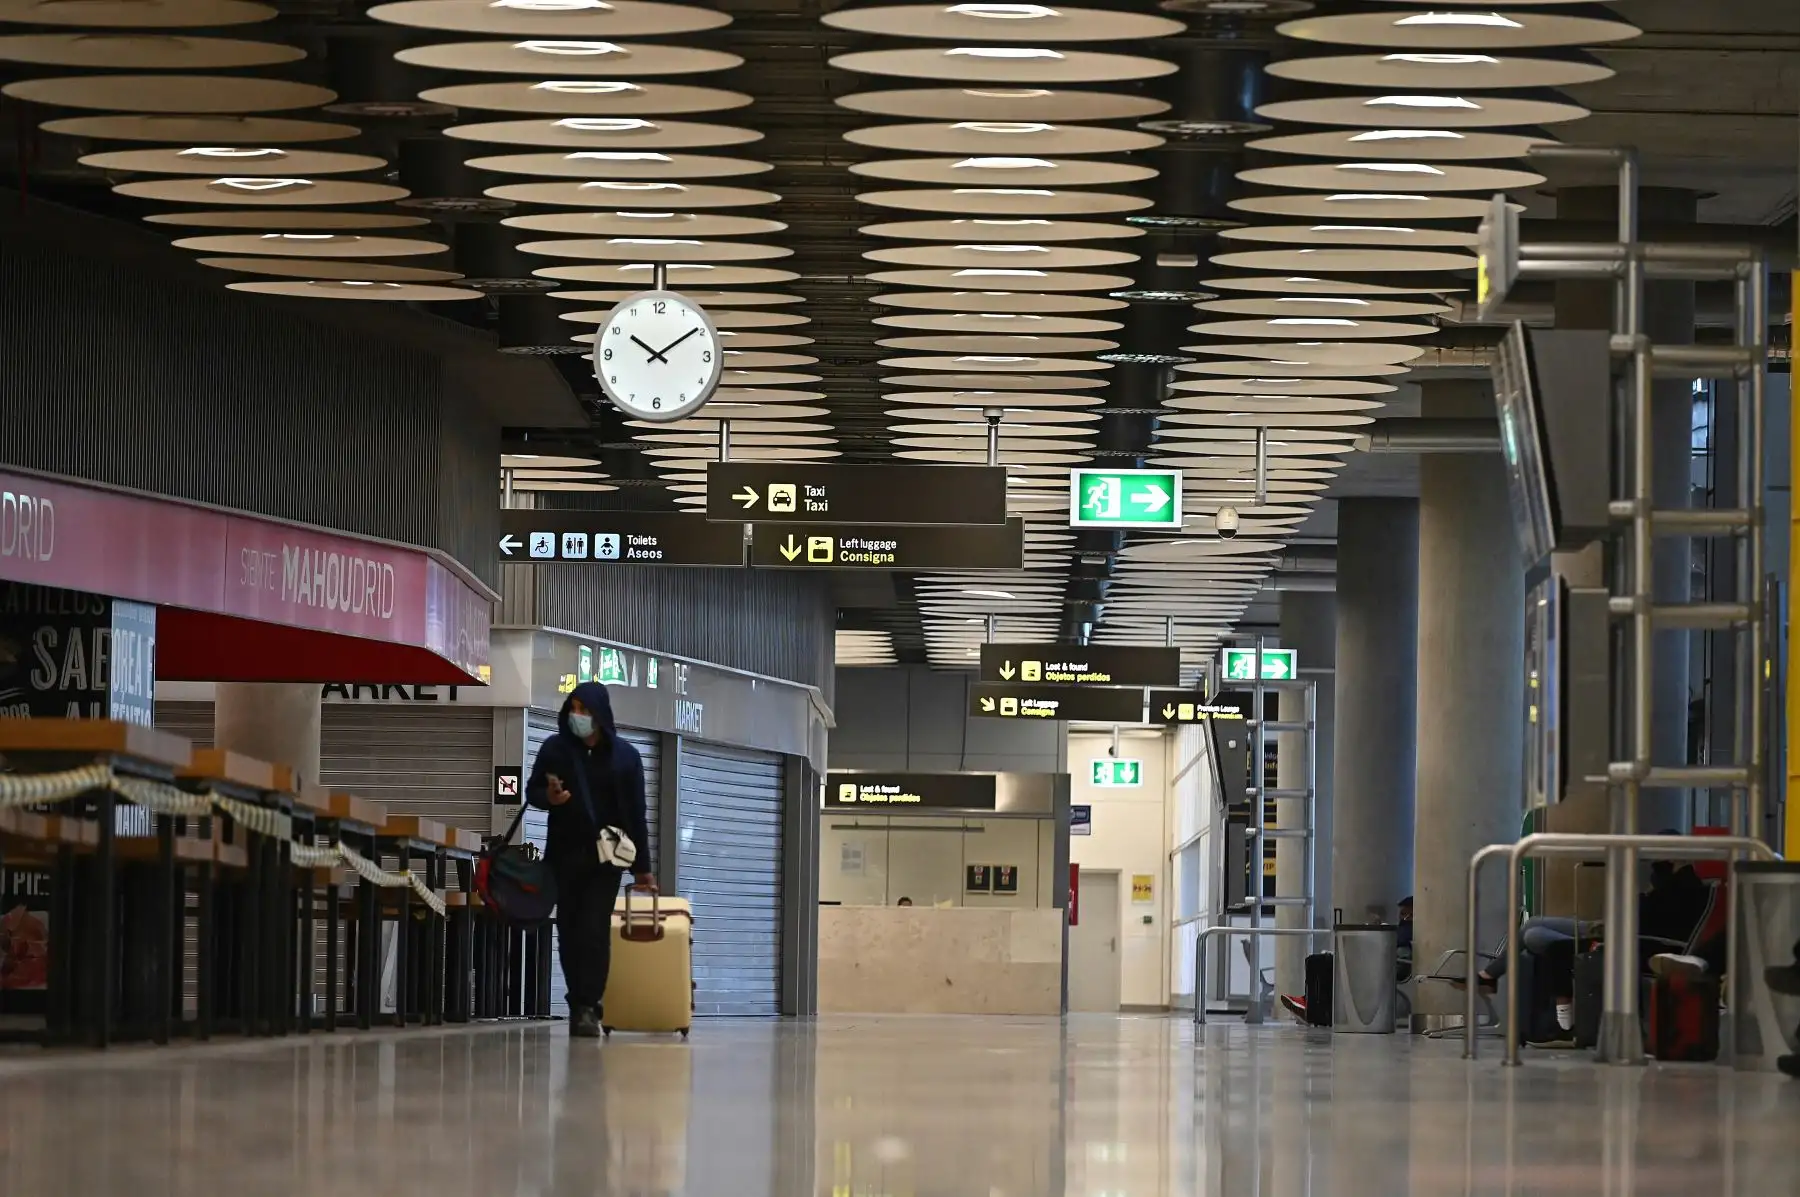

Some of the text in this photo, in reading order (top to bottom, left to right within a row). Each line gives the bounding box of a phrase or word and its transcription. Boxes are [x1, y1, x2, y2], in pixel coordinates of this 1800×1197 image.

[630, 308, 637, 316] 11
[653, 301, 666, 314] 12
[612, 327, 621, 335] 10
[604, 349, 613, 360] 9
[703, 351, 711, 363] 3
[652, 397, 661, 409] 6
[804, 485, 825, 496] Taxi
[804, 499, 828, 511] Taxi
[627, 534, 657, 545] Toilets
[840, 538, 897, 550] Left luggage
[627, 547, 662, 558] Aseos
[840, 550, 895, 564] Consigna
[281, 542, 394, 619] MAHOUDRID
[1045, 662, 1088, 671] Lost & found
[674, 662, 688, 695] THE
[1045, 671, 1111, 682] Objetos perdidos
[675, 699, 703, 733] MARKET
[1020, 706, 1056, 717] Consigna
